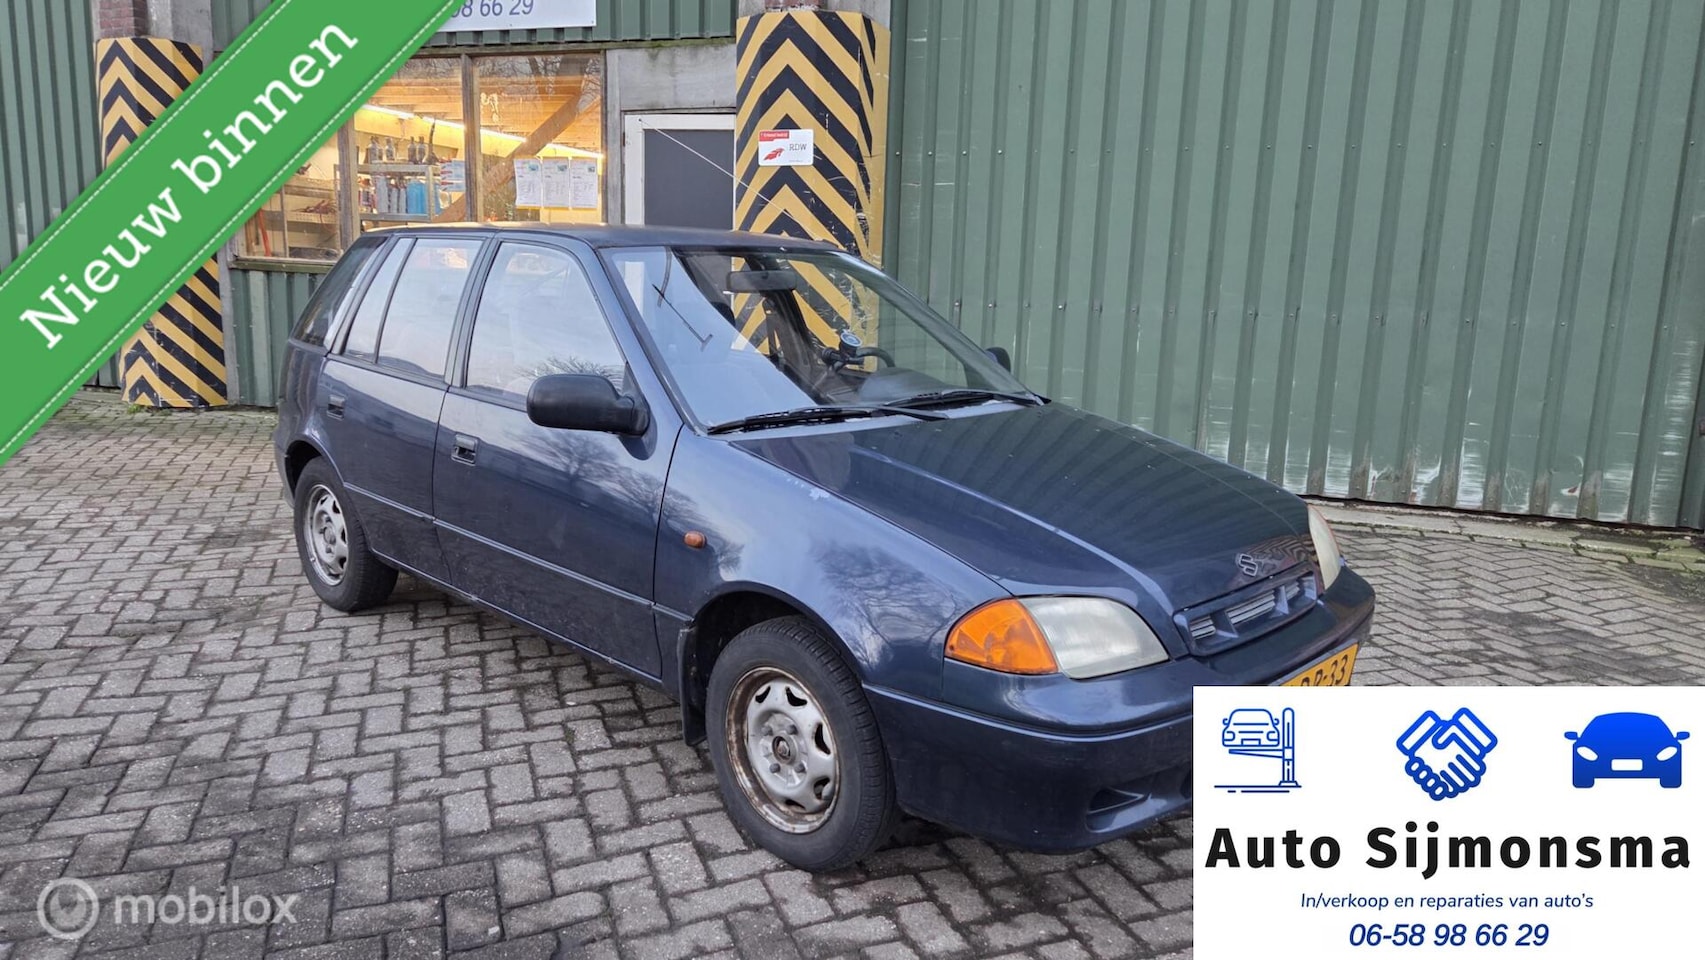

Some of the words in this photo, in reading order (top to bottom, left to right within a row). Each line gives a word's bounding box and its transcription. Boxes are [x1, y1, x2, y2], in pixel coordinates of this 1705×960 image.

[452, 0, 473, 17] 8
[480, 0, 503, 17] 66
[509, 0, 534, 16] 29
[788, 143, 807, 152] RDW
